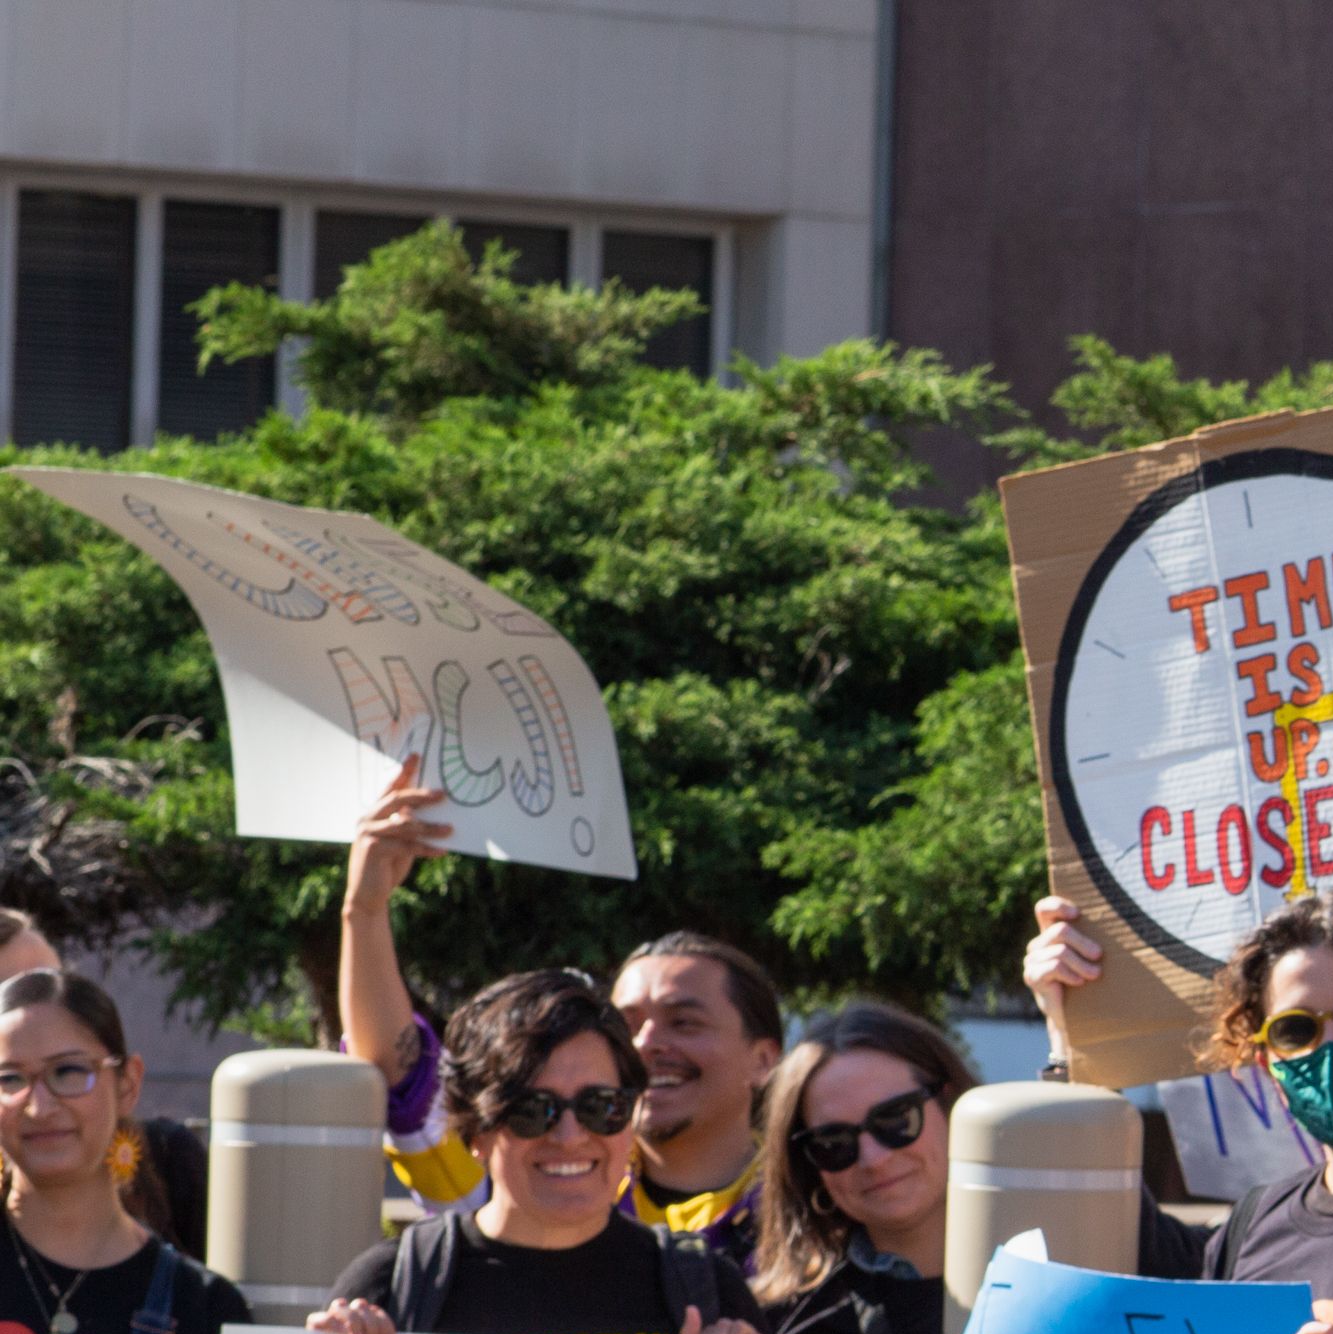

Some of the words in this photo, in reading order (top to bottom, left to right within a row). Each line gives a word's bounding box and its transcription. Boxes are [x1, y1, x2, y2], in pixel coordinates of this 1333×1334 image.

[1236, 642, 1325, 718] IS
[327, 646, 595, 858] MCJ!
[1246, 719, 1331, 784] UP.
